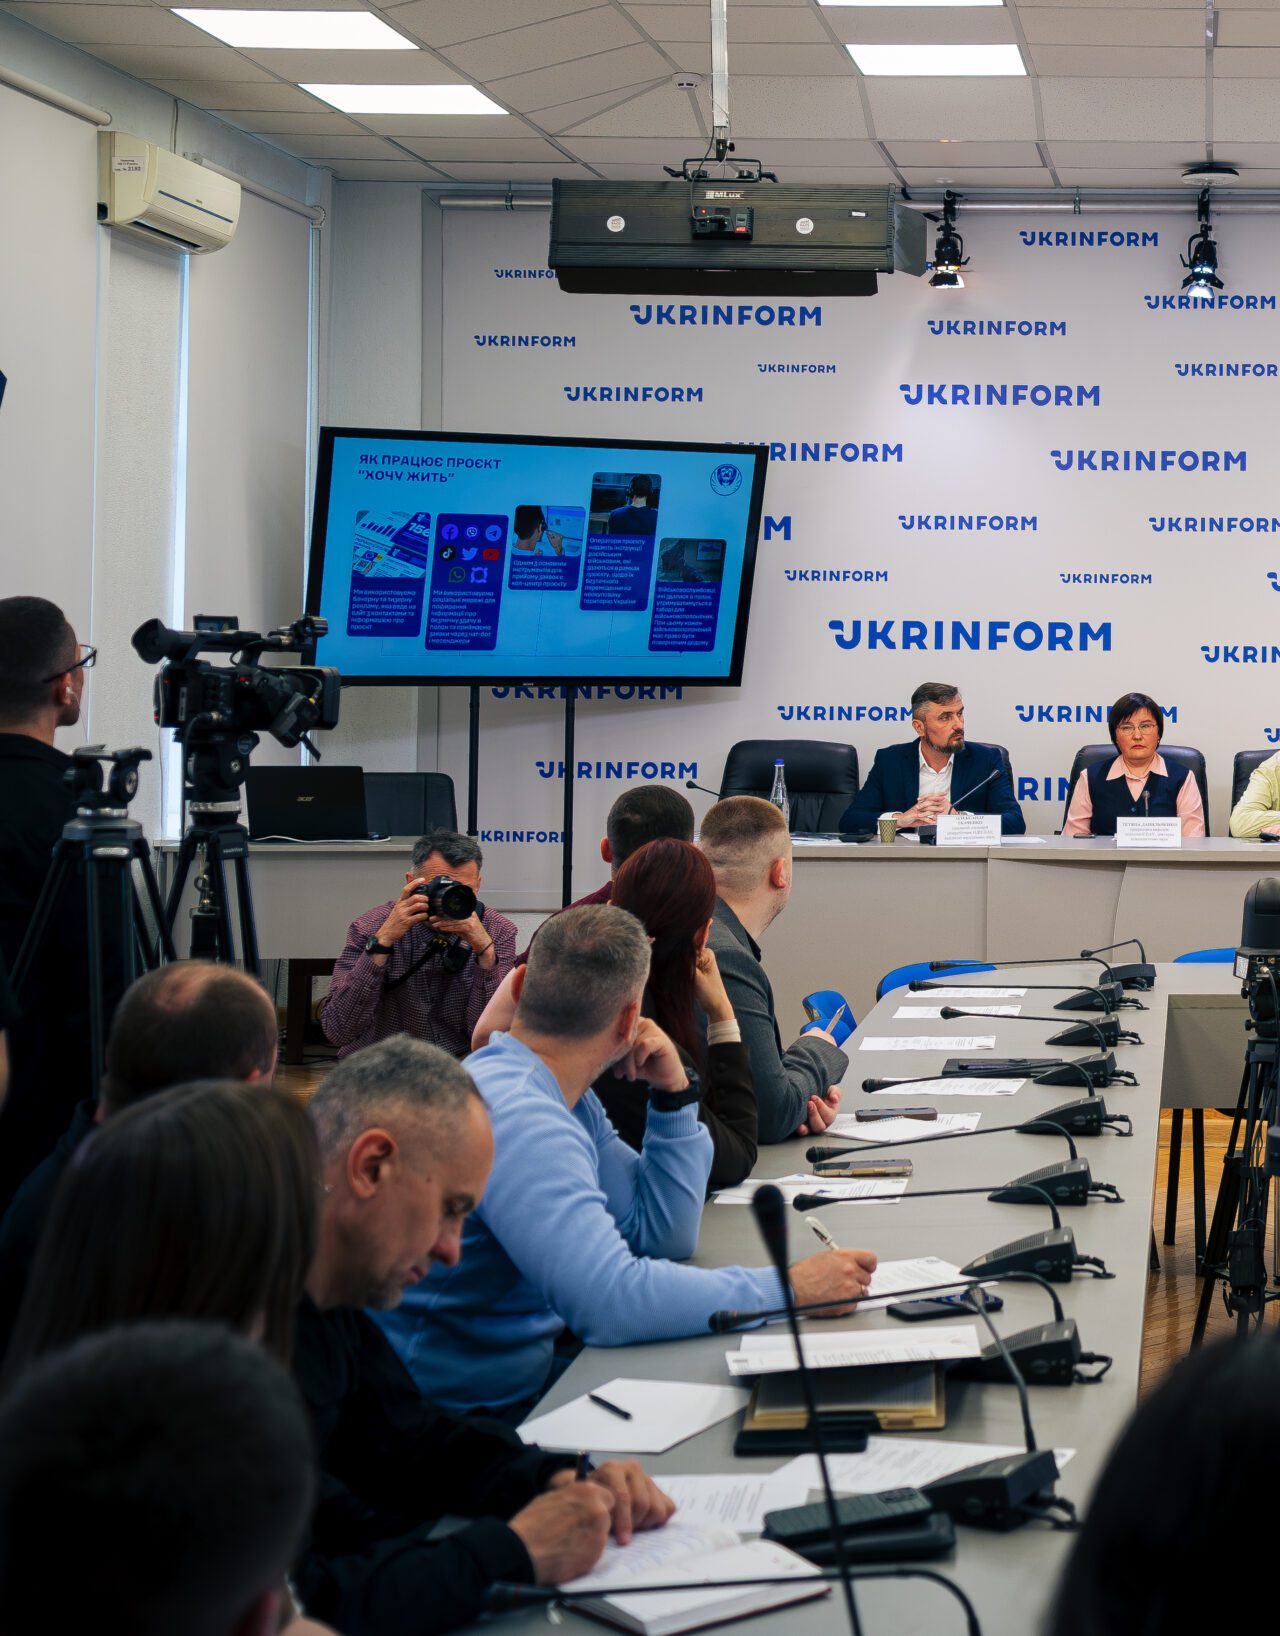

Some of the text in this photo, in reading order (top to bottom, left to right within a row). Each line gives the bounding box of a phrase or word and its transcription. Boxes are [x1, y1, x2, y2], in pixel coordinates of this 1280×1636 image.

[1020, 232, 1159, 247] UKRINFORM
[494, 269, 558, 279] UKRINFO
[1144, 294, 1277, 310] UKRINFORM
[630, 304, 822, 326] UKRINFORM
[928, 320, 1067, 335] UKRINFORM
[474, 335, 576, 347] UKRINFORM
[758, 363, 837, 373] UKRINFORM
[565, 386, 703, 401] UKRINFORM
[900, 384, 1100, 406] UKRINFORM
[770, 442, 903, 462] RINFORM
[360, 454, 501, 469] ЯК ПРАЦЮЄ ПРОЄКТ
[1051, 450, 1247, 471] UKRINFORM
[898, 516, 1038, 530] UKRINFORM
[785, 570, 888, 581] UKRINFORM
[1060, 574, 1152, 584] UKRINFORM
[828, 620, 1112, 651] UKRINFORM
[778, 706, 913, 721] UKRINFORM
[1015, 705, 1178, 723] UKRINM
